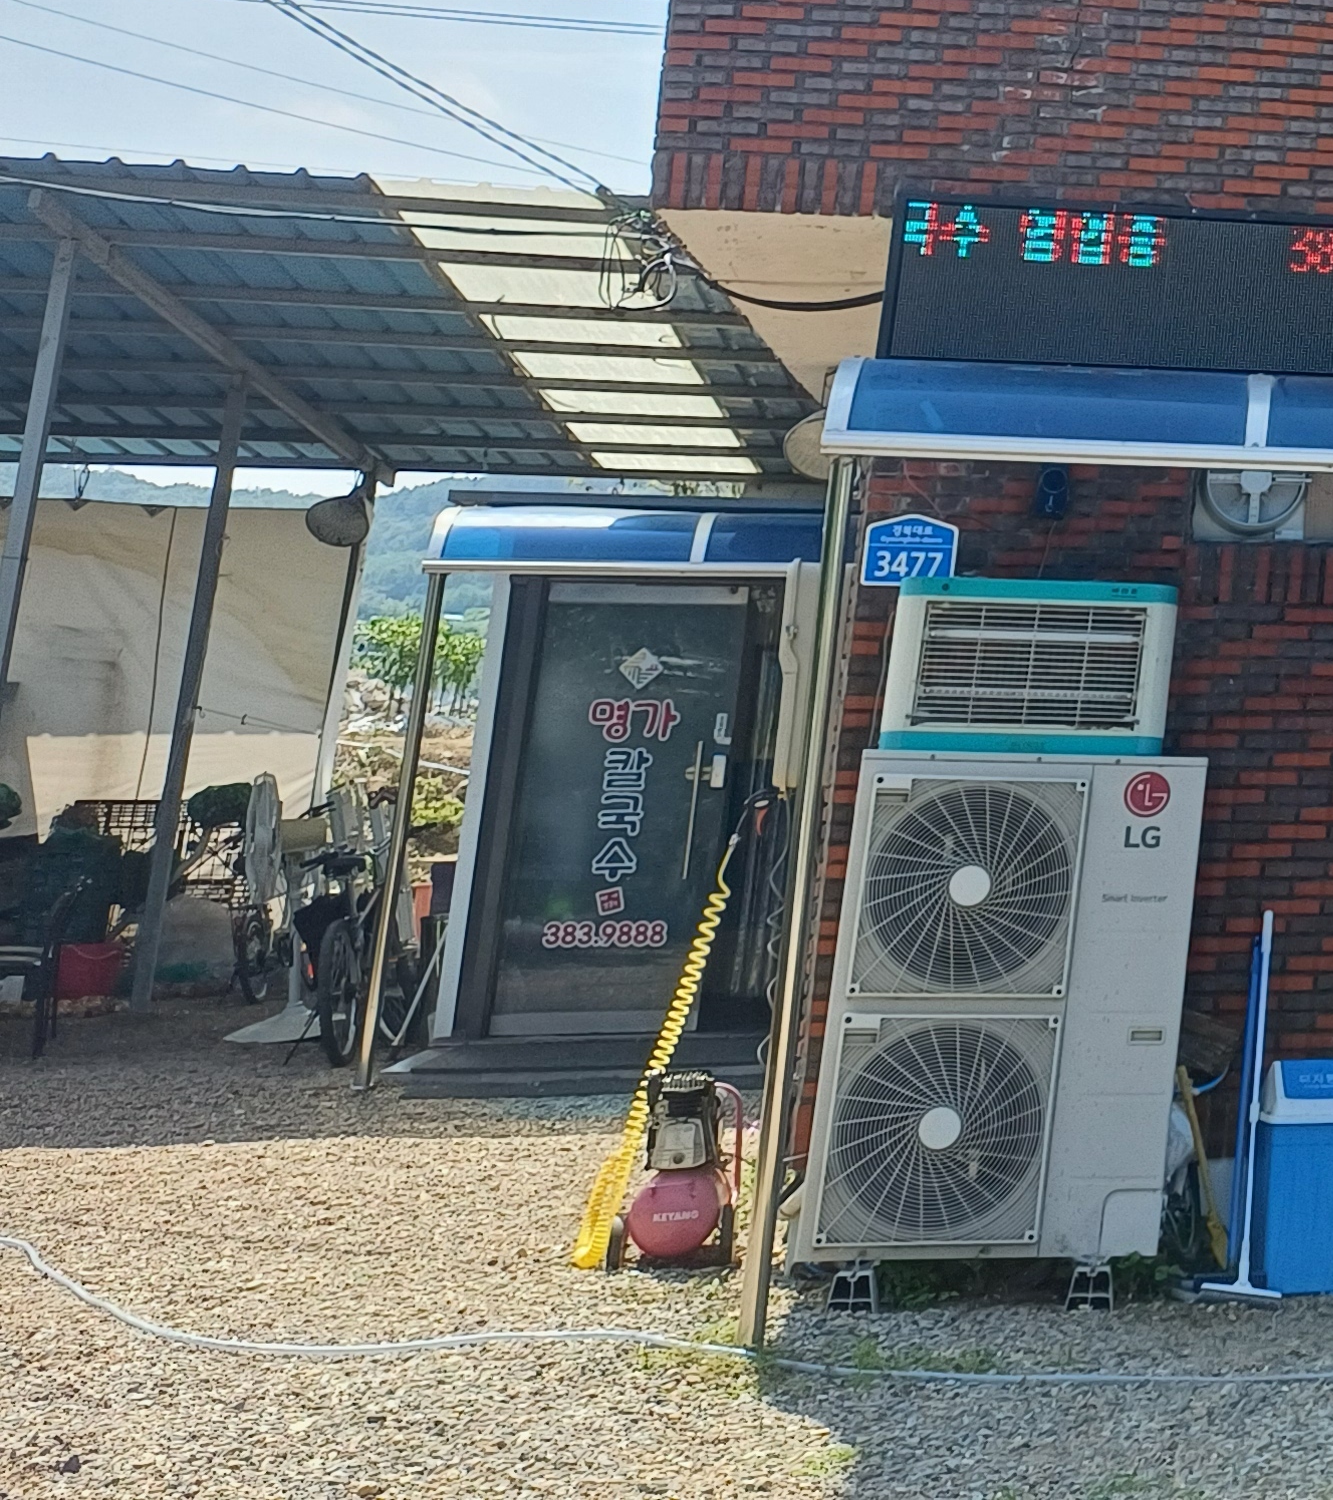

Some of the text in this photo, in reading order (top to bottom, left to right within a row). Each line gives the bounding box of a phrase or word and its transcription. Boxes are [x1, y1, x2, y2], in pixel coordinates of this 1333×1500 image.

[873, 549, 944, 578] 3477
[588, 699, 681, 743] 명가
[591, 748, 653, 883] 칼국수
[1124, 825, 1161, 849] LG
[541, 920, 669, 949] 383.9888
